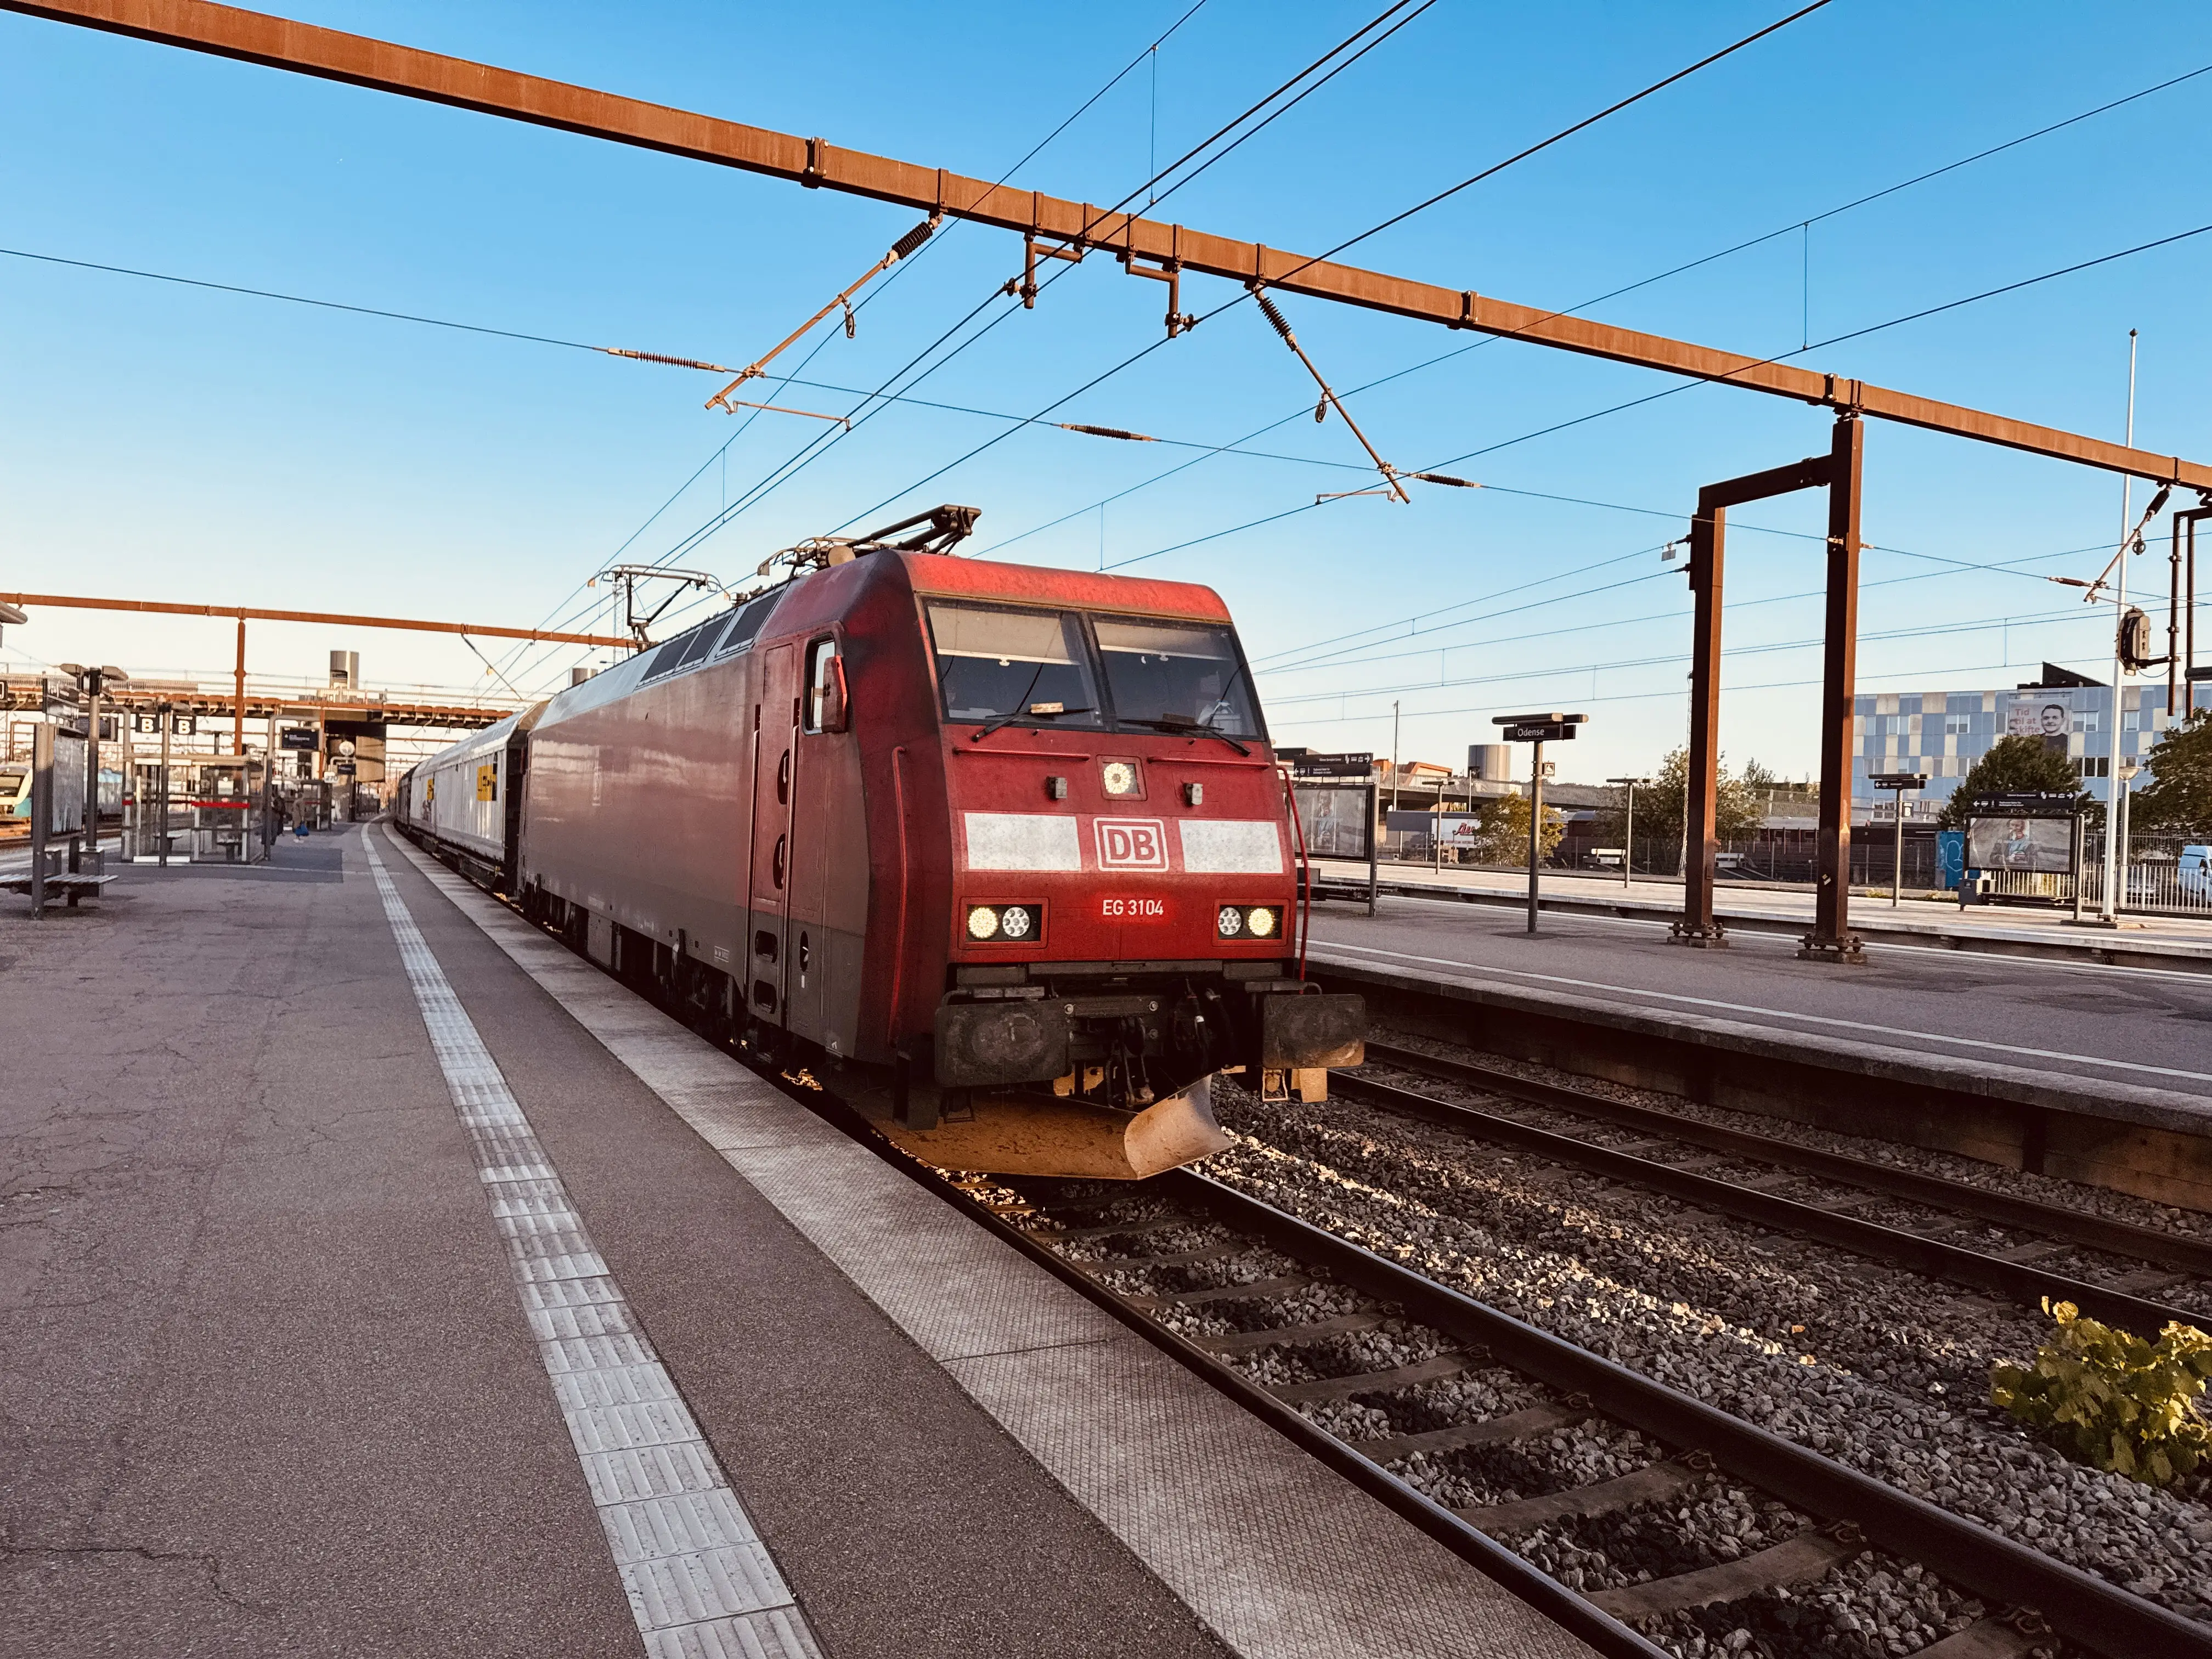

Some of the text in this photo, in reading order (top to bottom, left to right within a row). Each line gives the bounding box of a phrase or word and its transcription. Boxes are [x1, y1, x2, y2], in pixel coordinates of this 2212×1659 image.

[142, 718, 153, 732] B
[178, 720, 190, 734] B
[1517, 727, 1545, 737] Odense
[1108, 829, 1155, 860] DB
[1103, 899, 1164, 915] EG 3104
